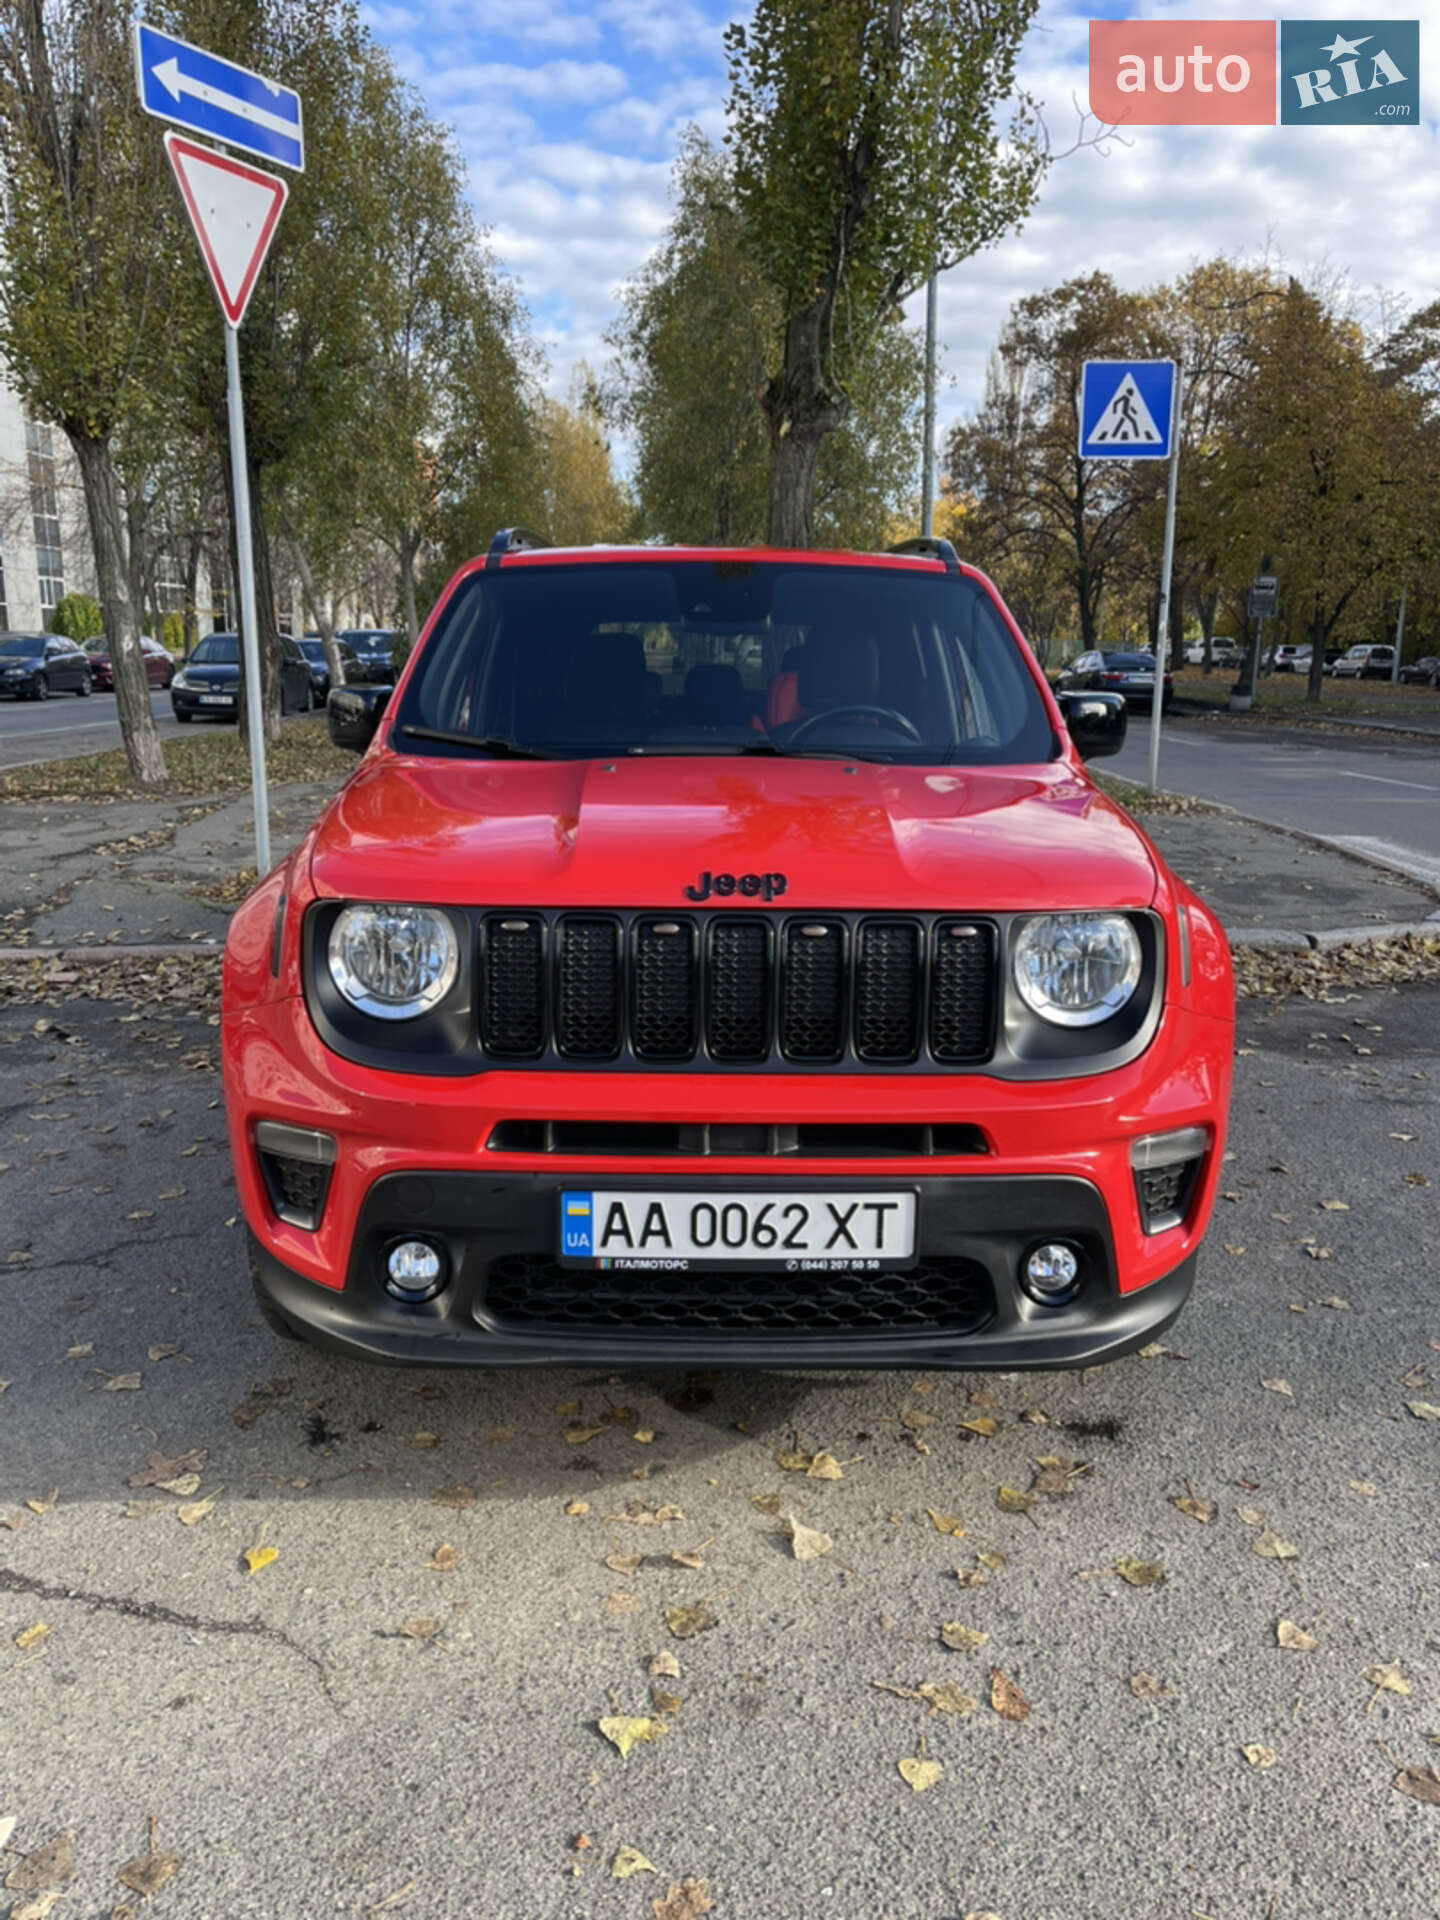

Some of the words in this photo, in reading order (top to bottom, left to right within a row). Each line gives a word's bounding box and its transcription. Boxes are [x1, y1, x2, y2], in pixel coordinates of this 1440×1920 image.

[685, 871, 788, 902] Jeep
[600, 1201, 674, 1249] AA
[690, 1202, 810, 1249] 0062
[824, 1202, 899, 1249] XT
[567, 1232, 590, 1248] UA
[830, 1259, 849, 1270] 207
